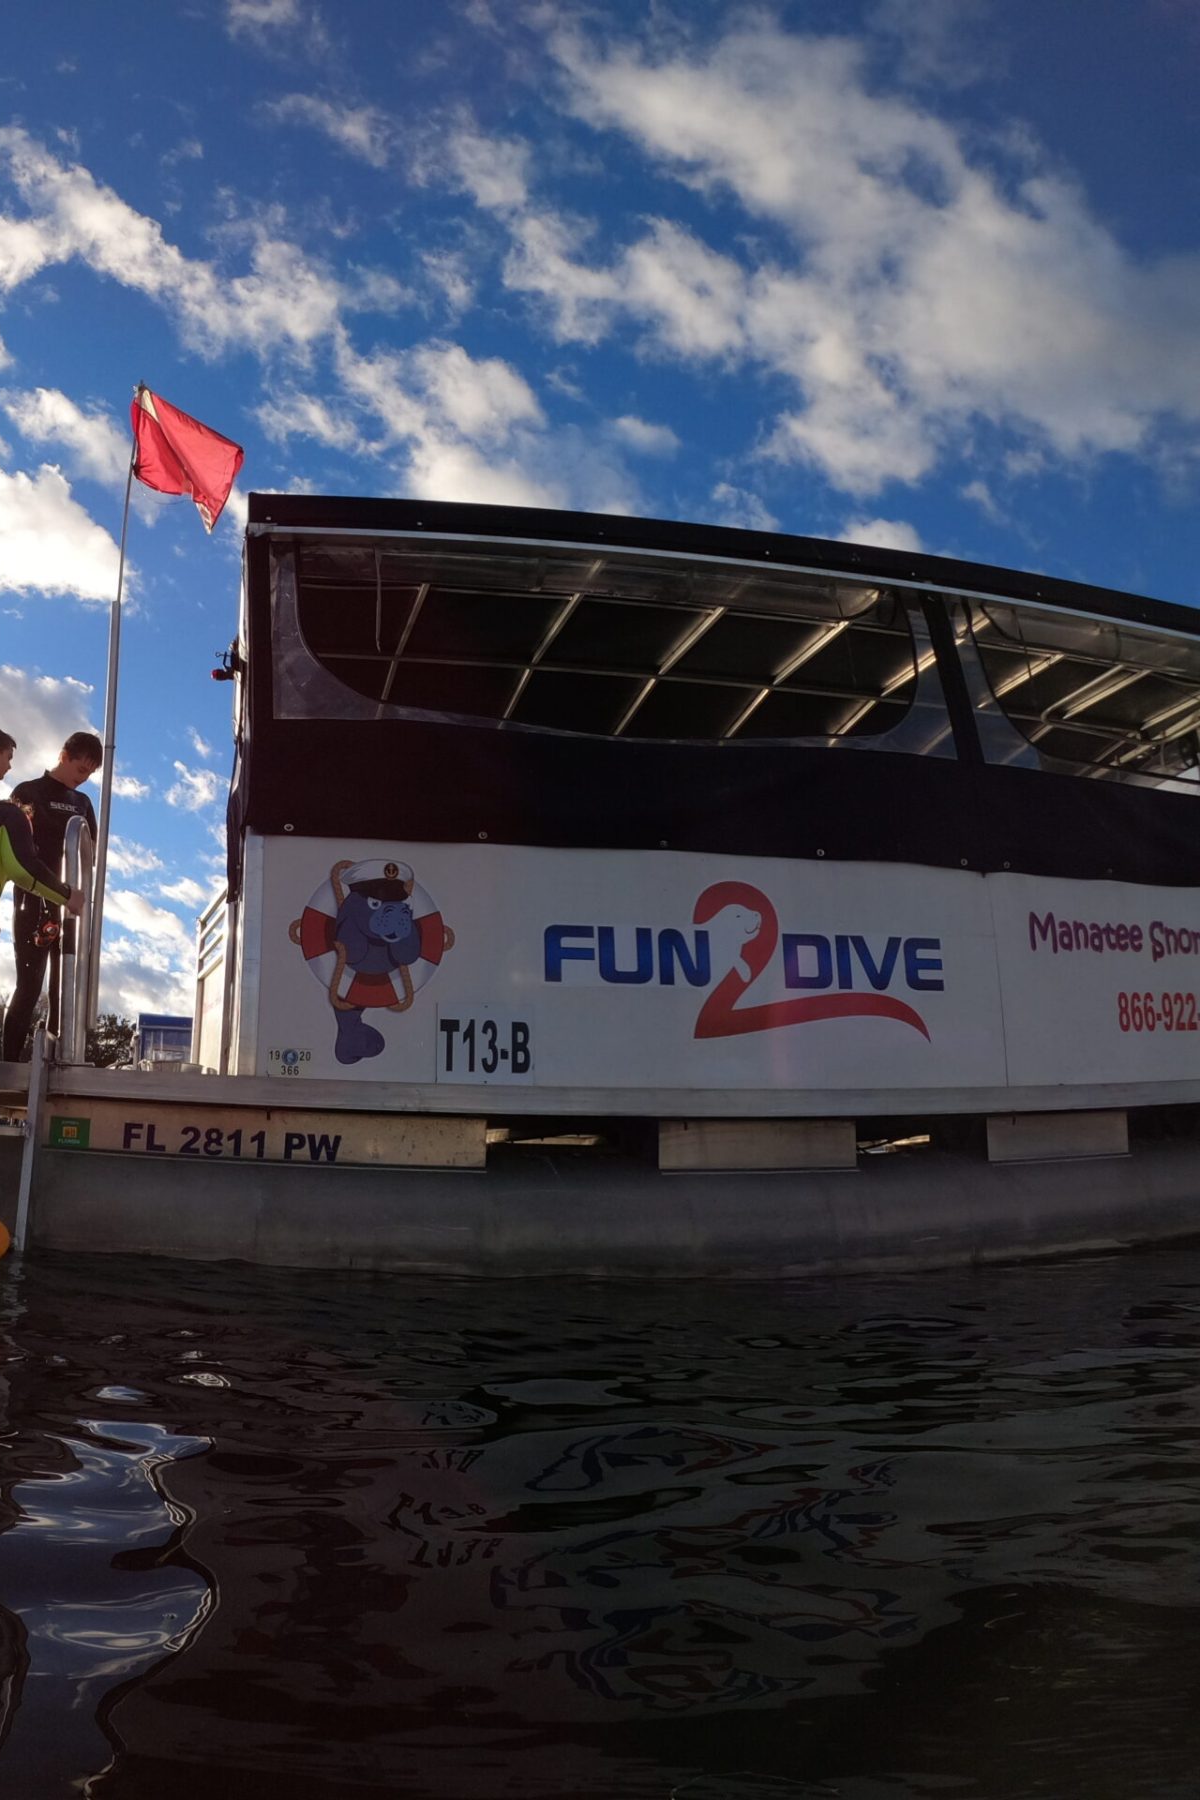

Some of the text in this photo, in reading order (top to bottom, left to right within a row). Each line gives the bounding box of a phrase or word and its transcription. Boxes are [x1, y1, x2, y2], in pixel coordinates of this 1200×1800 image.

[50, 801, 78, 813] seac
[1029, 912, 1143, 954] Manatee
[269, 1050, 311, 1061] 19 20
[440, 1018, 531, 1074] T13-B
[281, 1065, 299, 1076] 366
[123, 1123, 341, 1161] FL 2811 PW
